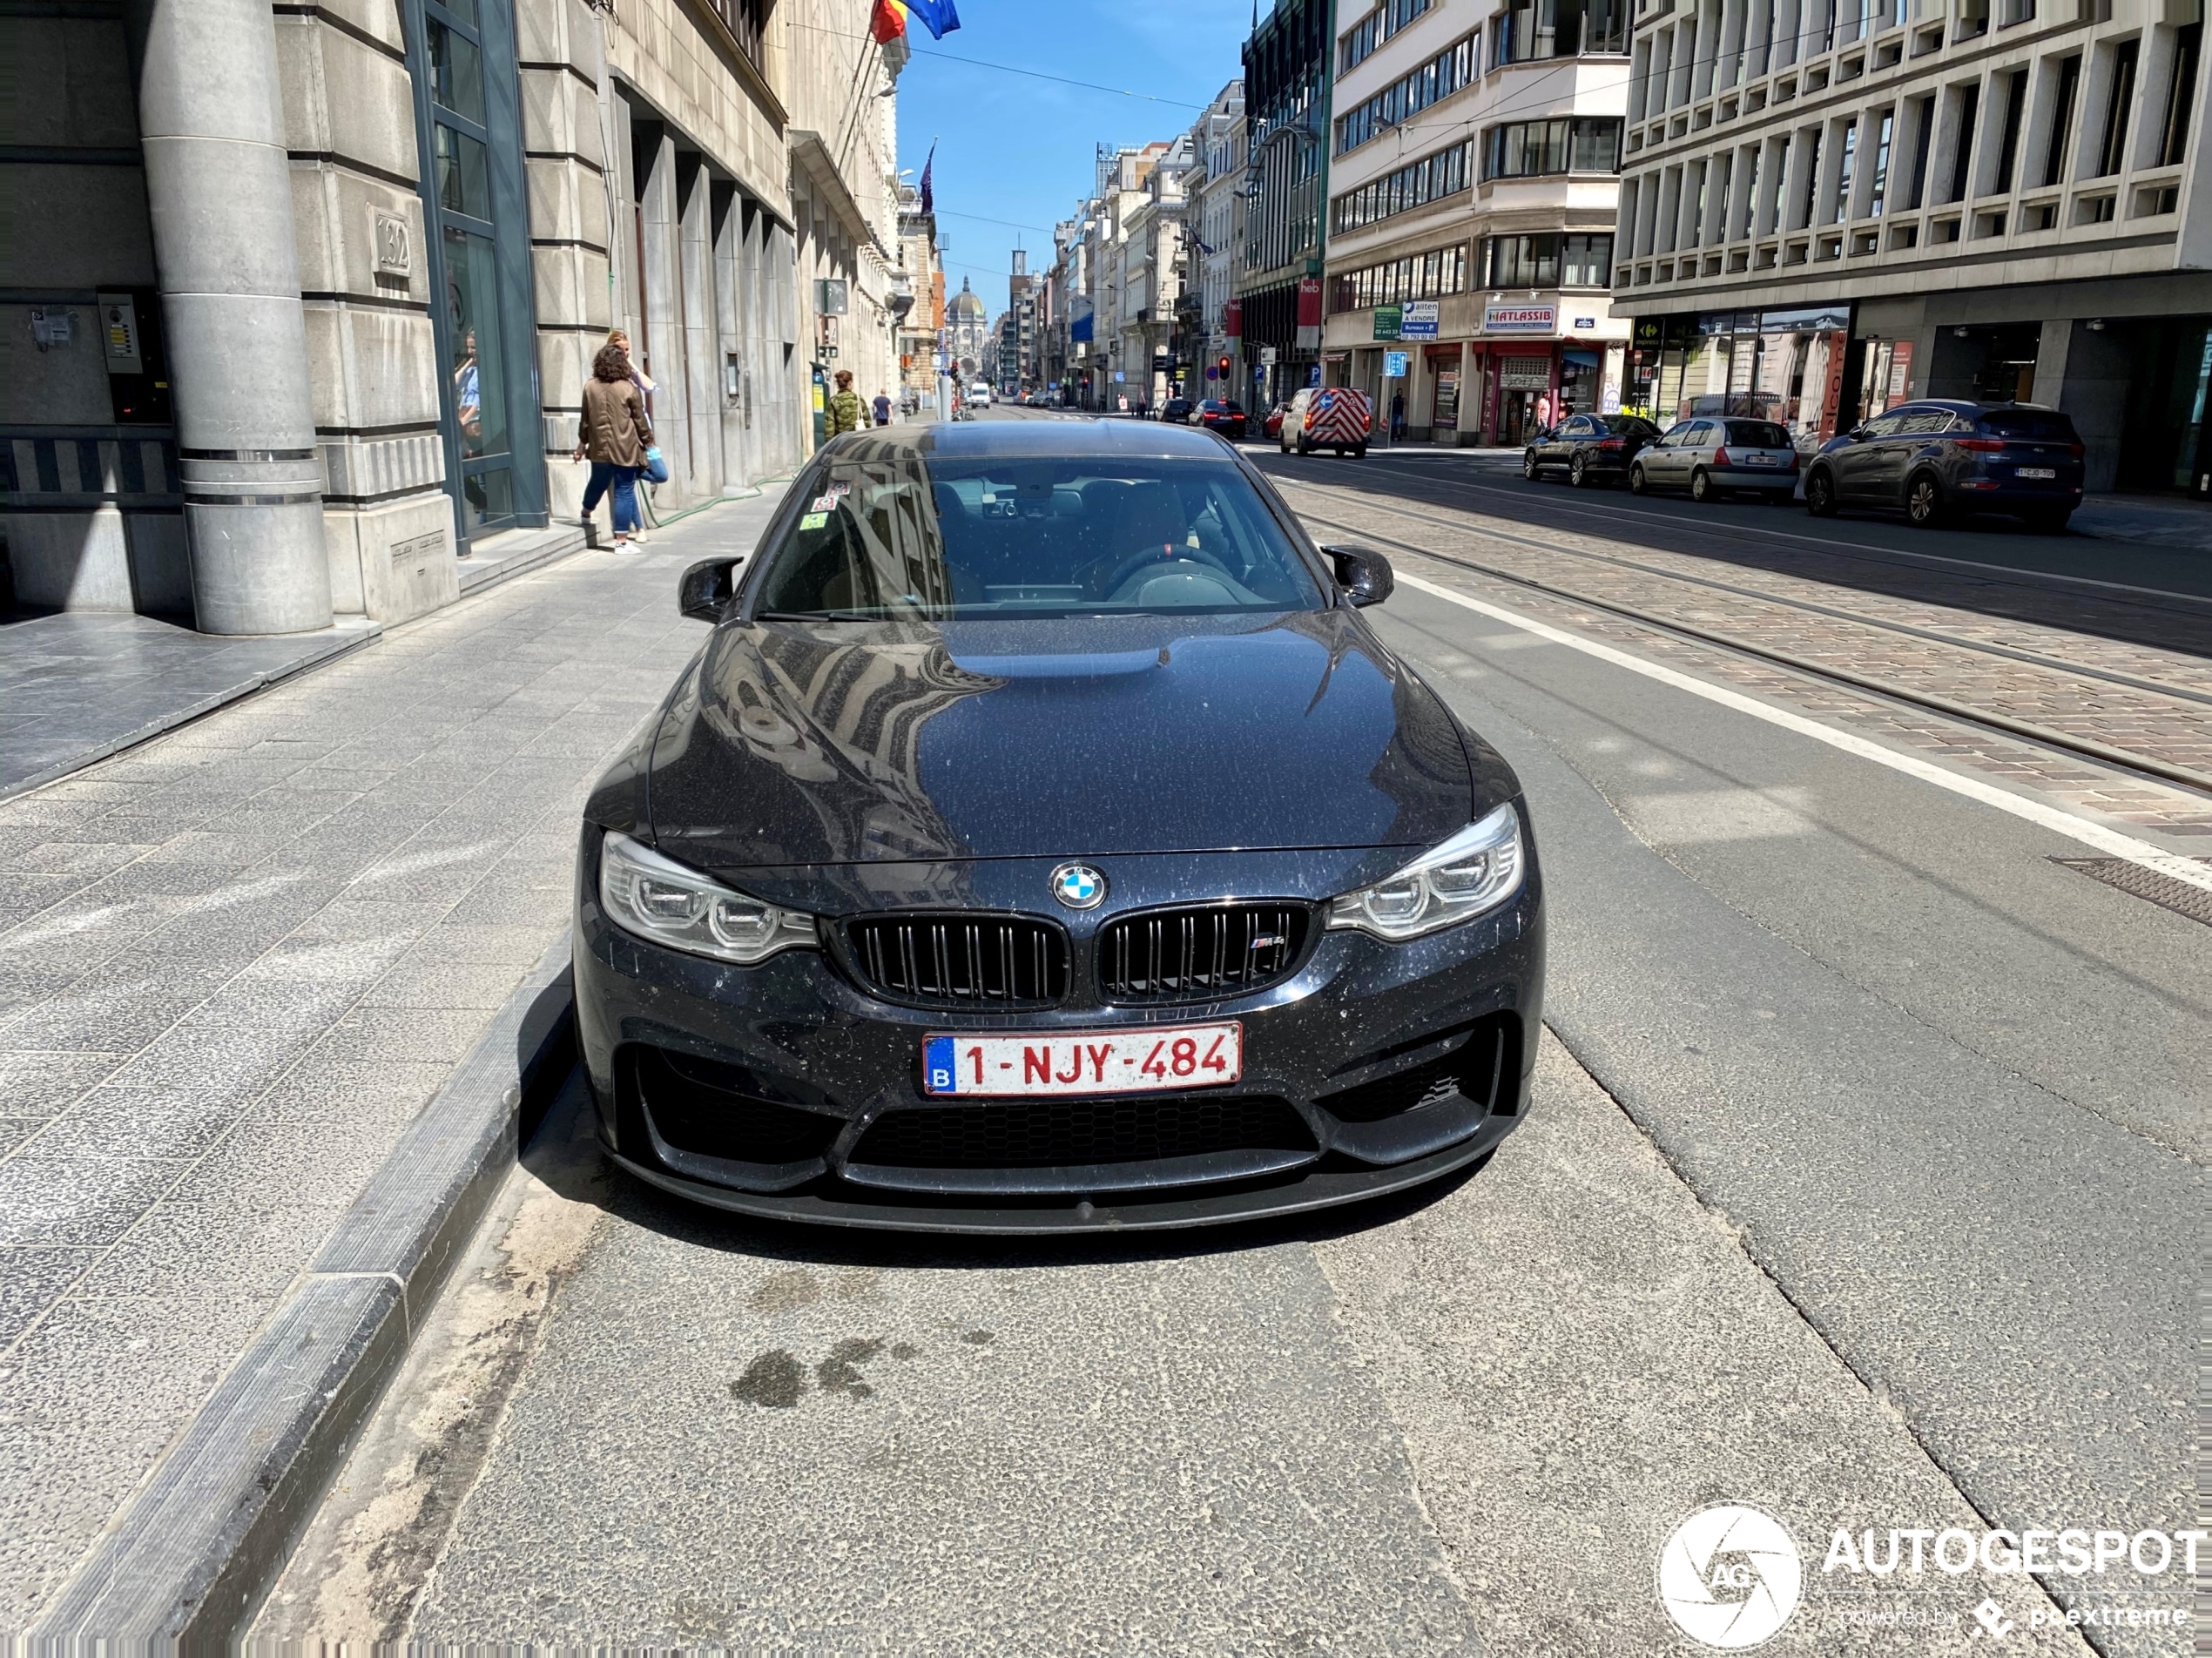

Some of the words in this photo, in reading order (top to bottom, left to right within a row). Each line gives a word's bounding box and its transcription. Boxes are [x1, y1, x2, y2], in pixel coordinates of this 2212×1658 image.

[377, 219, 408, 267] 132
[1300, 280, 1319, 293] heb
[1499, 311, 1551, 321] ATLASSIB
[933, 1068, 950, 1087] B
[966, 1035, 1226, 1085] 1-NJY-484
